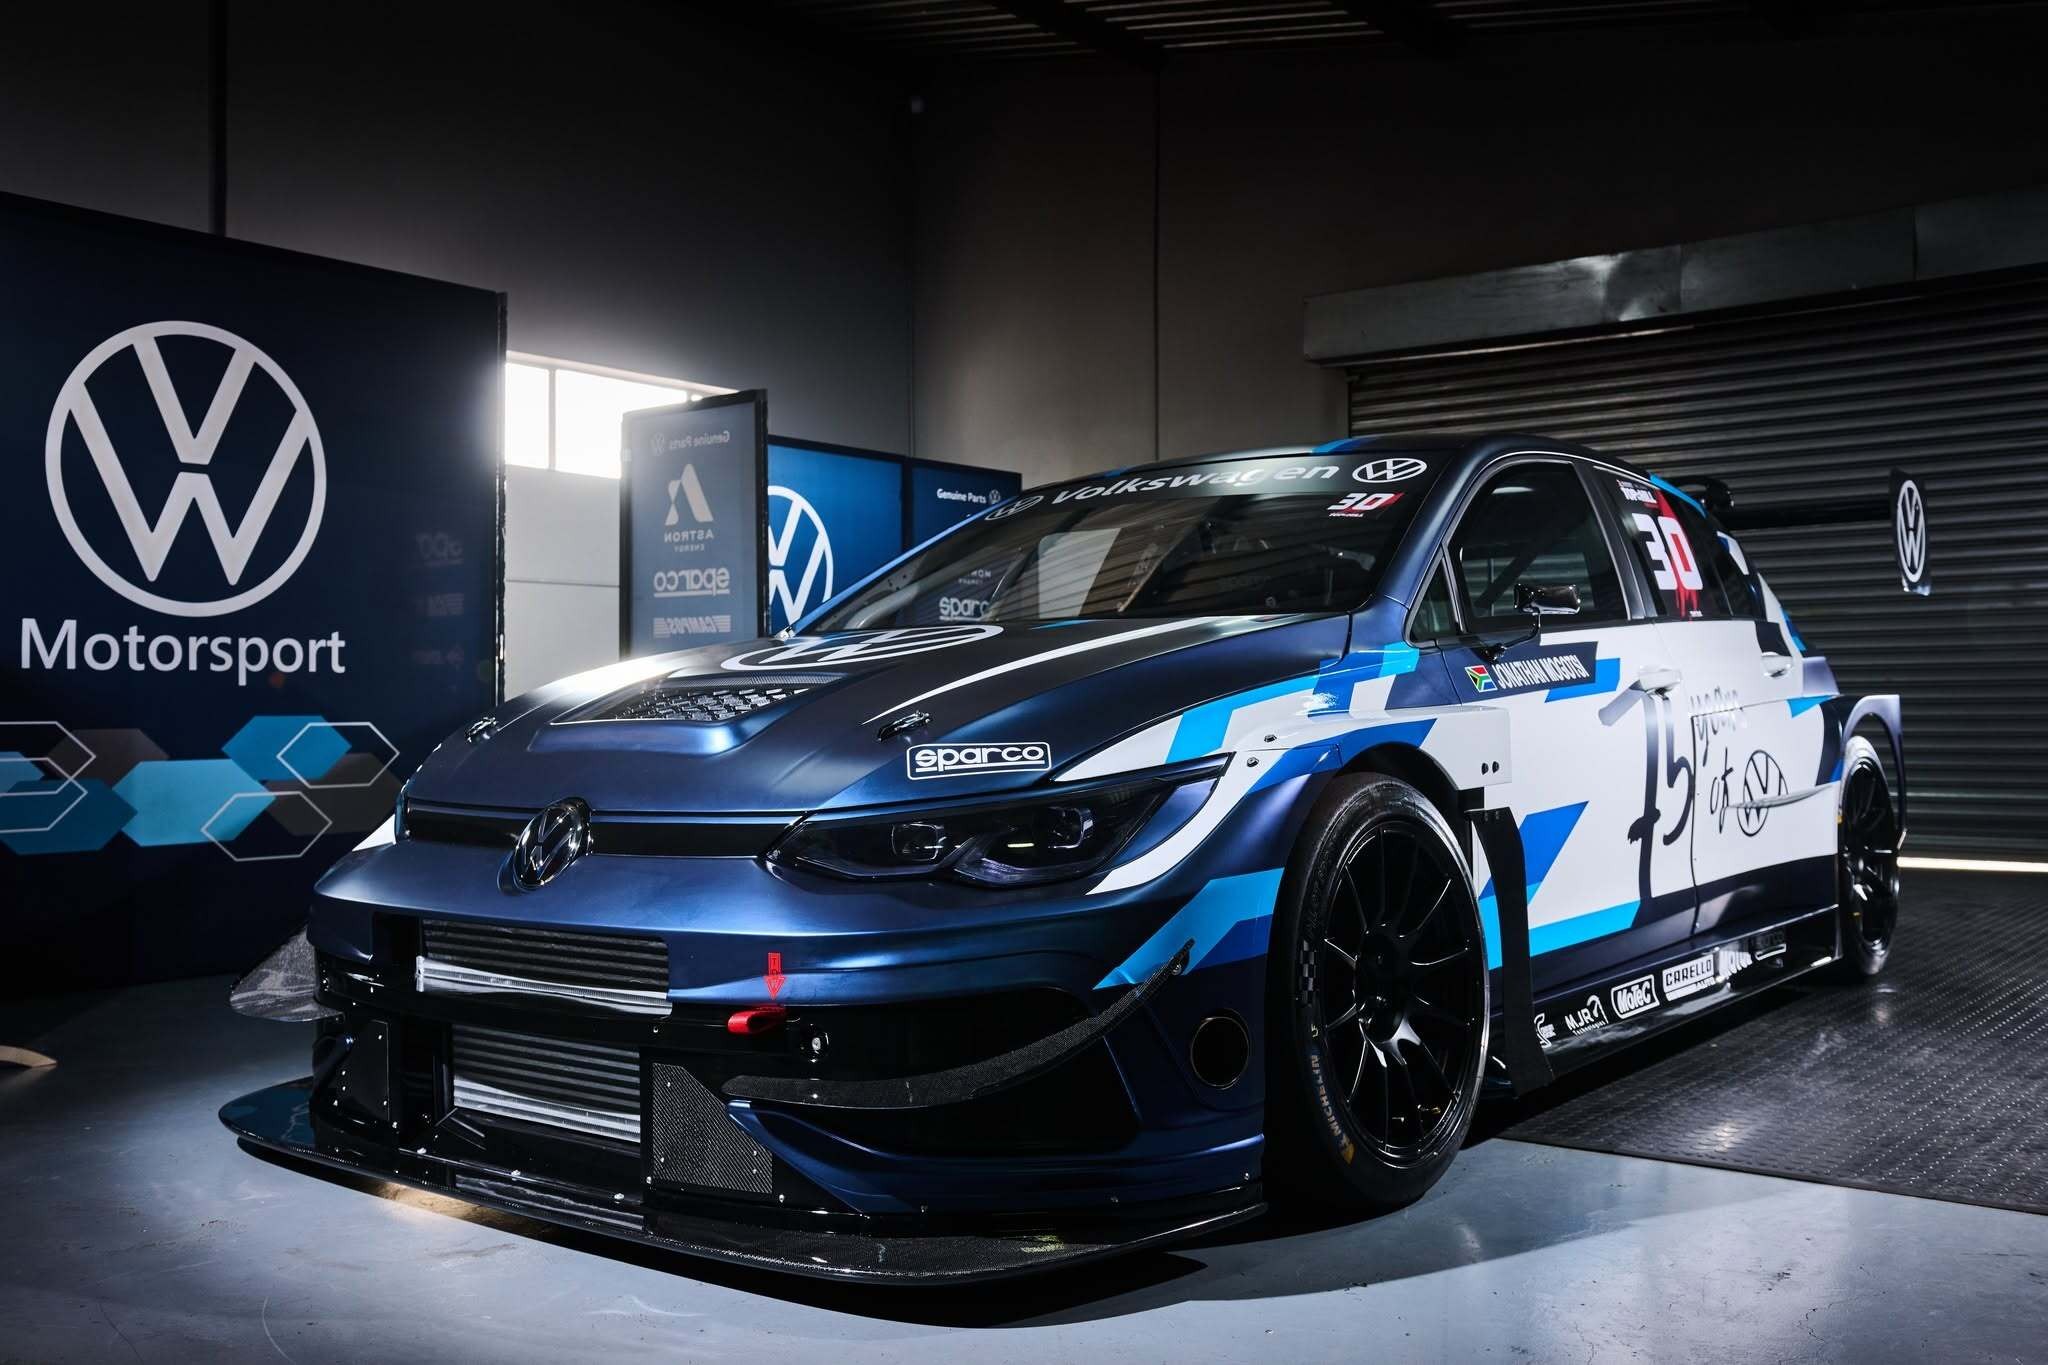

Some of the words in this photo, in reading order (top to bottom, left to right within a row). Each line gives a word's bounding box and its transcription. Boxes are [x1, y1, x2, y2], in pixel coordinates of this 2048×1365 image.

[936, 488, 967, 502] Genuine
[968, 492, 987, 504] Parts
[1051, 464, 1340, 505] Volkswagen
[1327, 493, 1395, 510] 30
[1631, 512, 1704, 590] 30
[939, 596, 992, 618] sparc
[20, 618, 346, 686] Motorsport
[1491, 659, 1551, 689] JONATHAN
[915, 745, 1045, 773] sparco
[1665, 959, 1713, 987] CARELLO
[1564, 1007, 1595, 1031] MJR
[1310, 1054, 1342, 1136] MICHELIN
